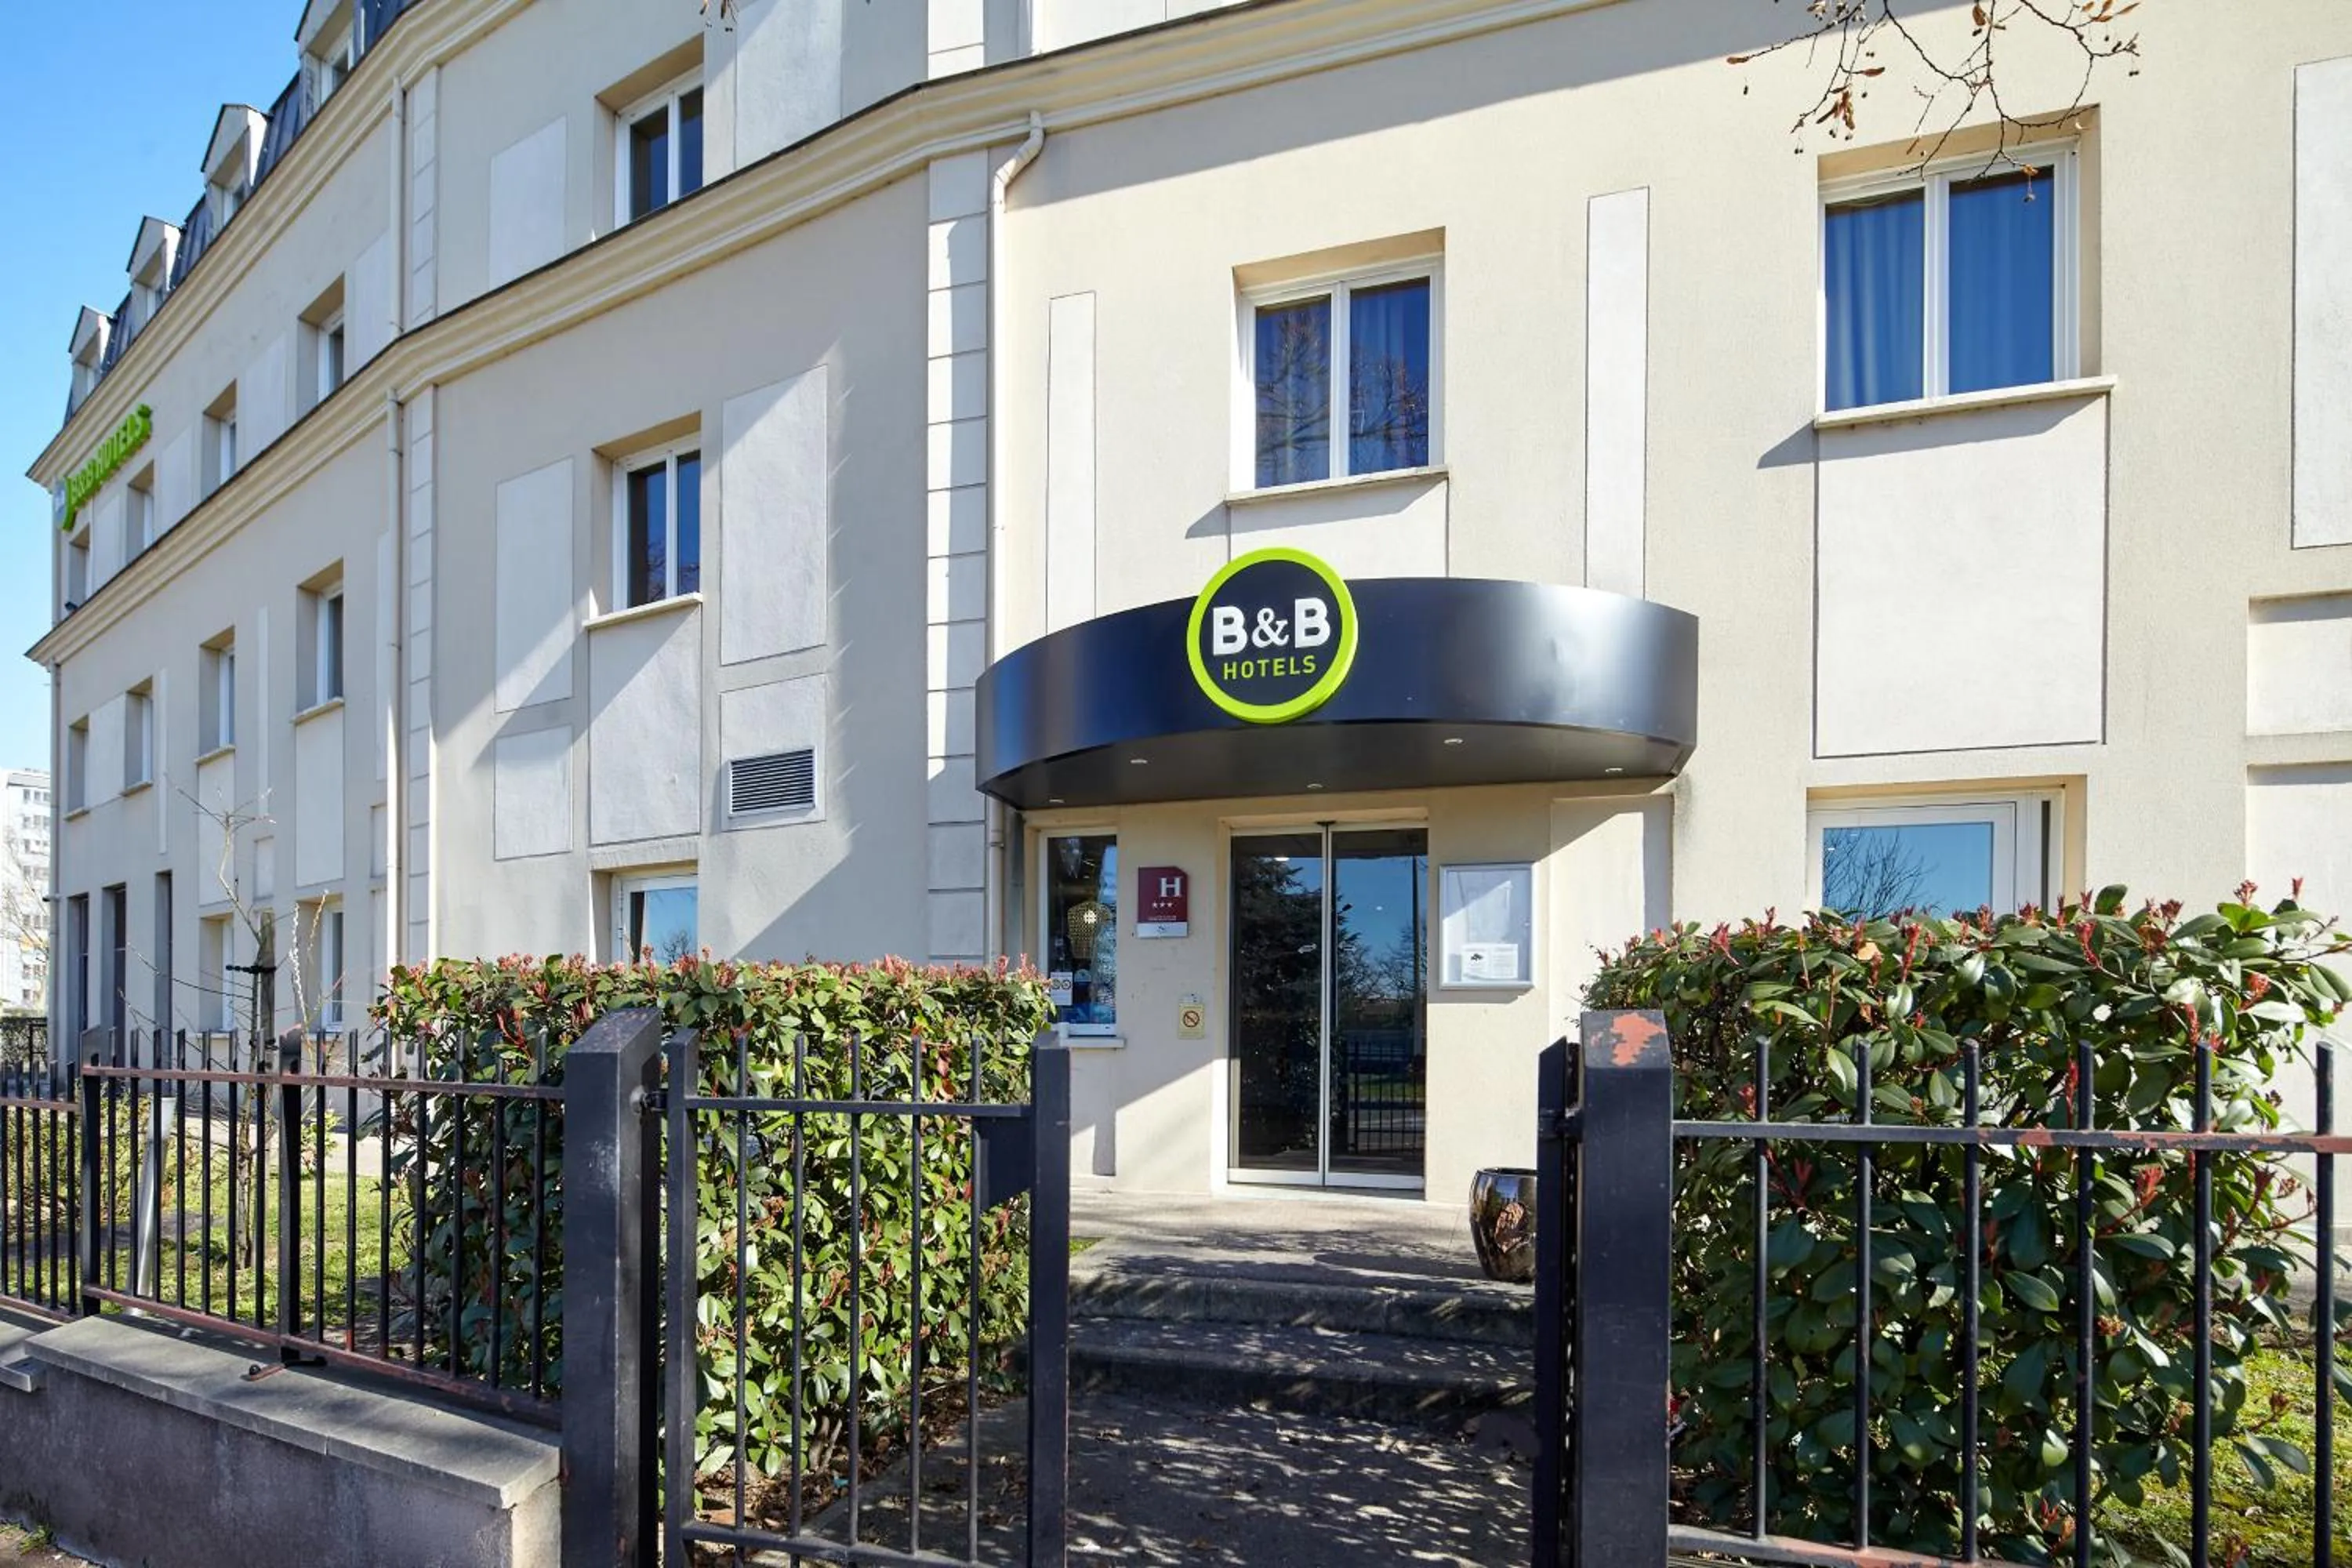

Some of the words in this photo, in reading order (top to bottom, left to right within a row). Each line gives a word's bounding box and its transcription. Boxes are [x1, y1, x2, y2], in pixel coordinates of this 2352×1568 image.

[1213, 597, 1330, 655] B&B
[1223, 655, 1316, 680] HOTELS
[1160, 877, 1181, 897] H
